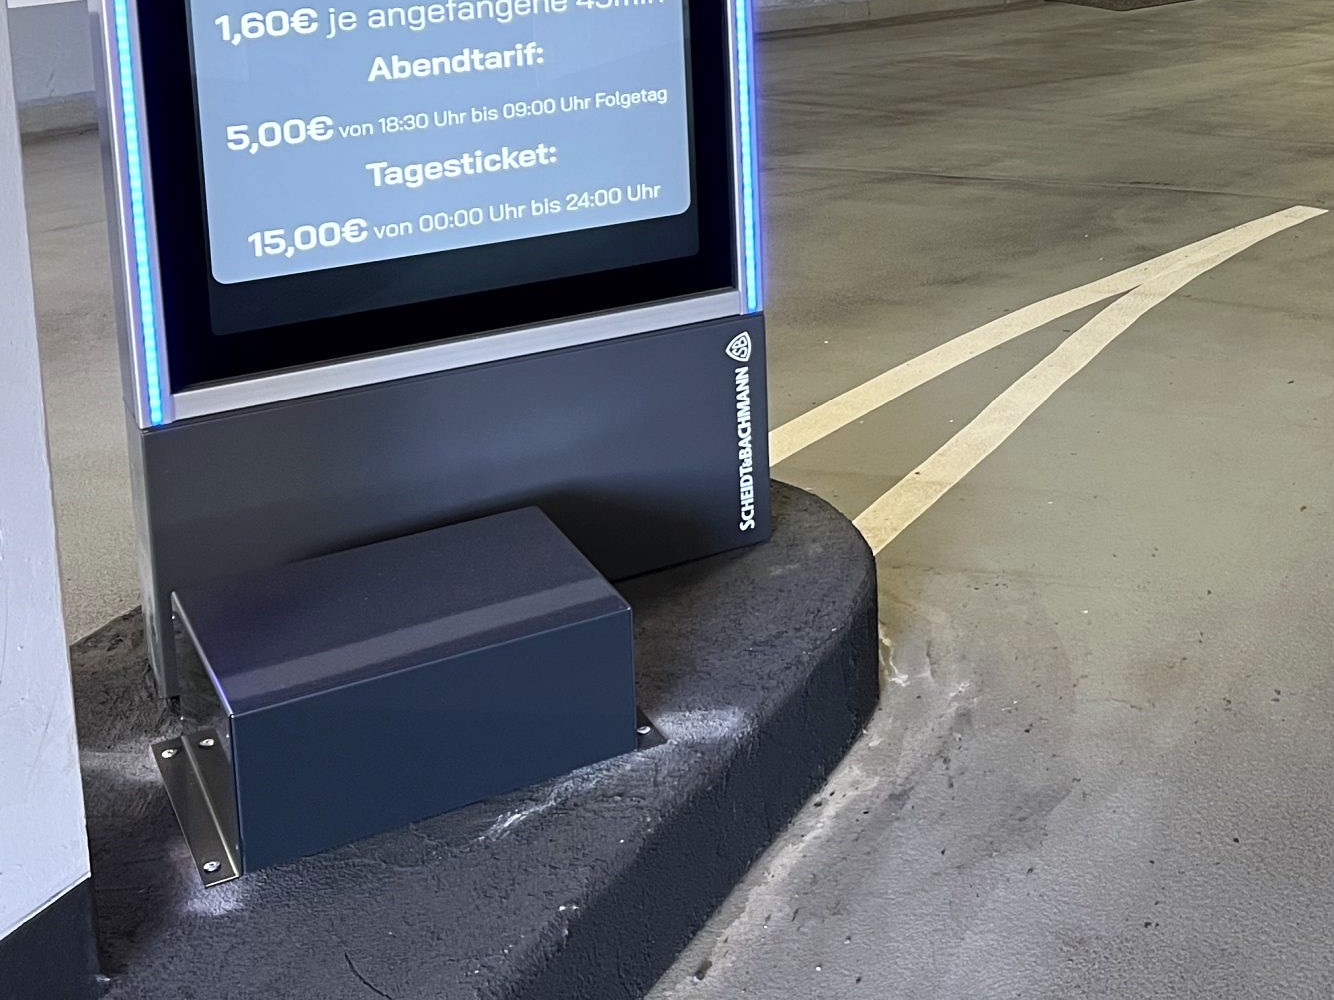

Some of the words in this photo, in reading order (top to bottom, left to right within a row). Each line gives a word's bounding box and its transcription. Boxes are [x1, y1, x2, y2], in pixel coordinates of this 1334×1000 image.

[214, 8, 318, 45] 1,60€
[325, 5, 358, 38] je
[368, 41, 544, 82] Abendtarif:
[226, 115, 334, 154] 5,00€
[338, 121, 374, 138] von
[378, 113, 429, 133] 18:30
[434, 110, 466, 127] Uhr
[471, 107, 499, 123] bis
[503, 99, 556, 119] 09:00
[560, 96, 592, 112] Uhr
[595, 88, 668, 108] Folgetag
[365, 143, 558, 188] Tagesticket:
[247, 218, 369, 258] 15,00€
[373, 220, 413, 240] von
[418, 208, 484, 233] 00:00
[489, 202, 526, 222] Uhr
[531, 197, 561, 216] bis
[566, 187, 622, 210] 24:00
[627, 183, 662, 202] Uhr
